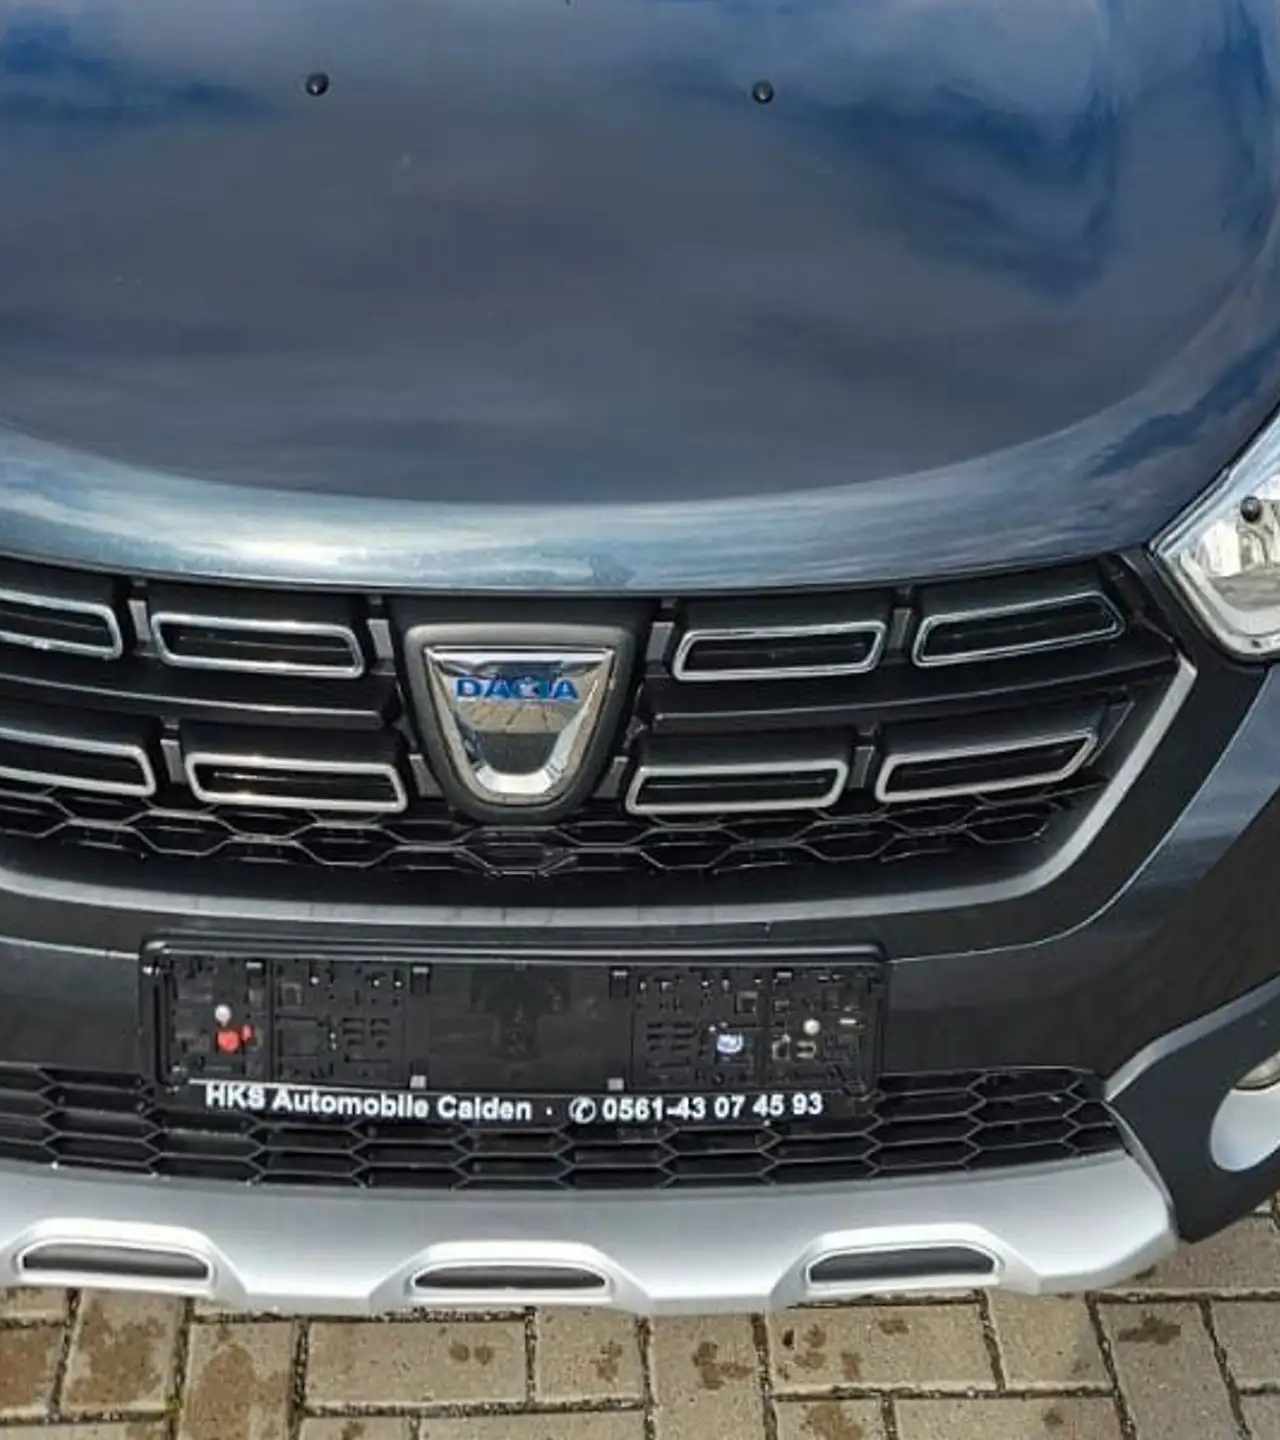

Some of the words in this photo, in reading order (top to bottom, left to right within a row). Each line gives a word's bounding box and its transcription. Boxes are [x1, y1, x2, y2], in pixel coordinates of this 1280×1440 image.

[204, 1081, 266, 1110] HKS
[272, 1089, 429, 1119] Automobile
[436, 1094, 533, 1120] Calden
[602, 1095, 706, 1122] 0561-43
[714, 1096, 746, 1119] 07
[752, 1093, 785, 1117] 45
[792, 1092, 824, 1116] 93
